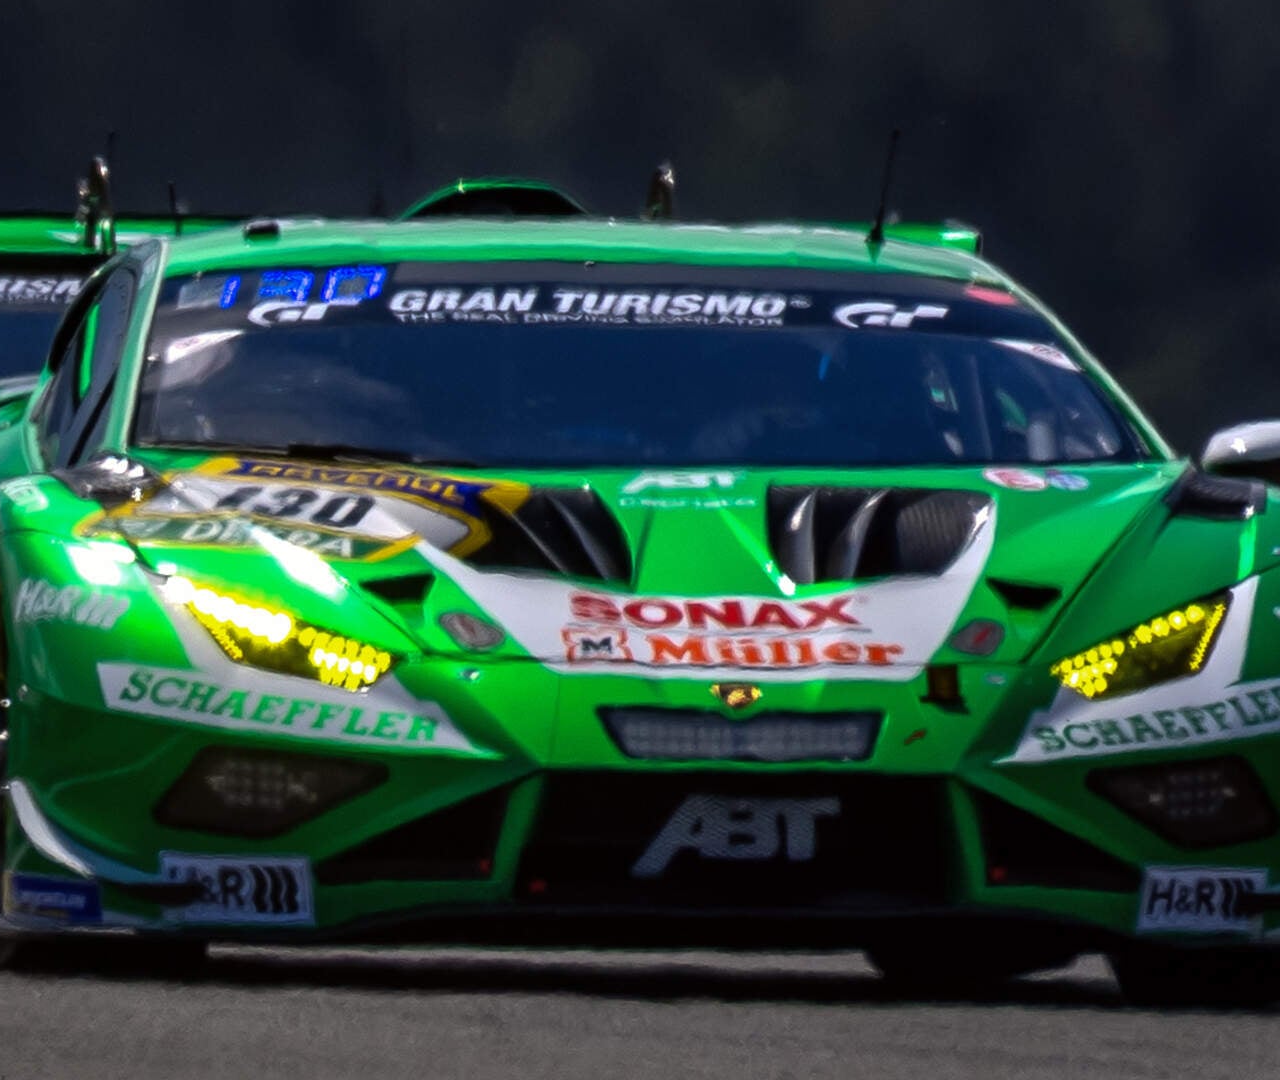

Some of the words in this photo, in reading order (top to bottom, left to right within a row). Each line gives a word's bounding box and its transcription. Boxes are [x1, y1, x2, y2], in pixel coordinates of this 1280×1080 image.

[389, 287, 537, 312] GRAN
[552, 288, 787, 317] TURISMO
[247, 463, 467, 507] RAVENOL
[215, 484, 377, 529] 130
[567, 590, 860, 630] SONAX
[648, 633, 904, 667] Müller
[120, 669, 439, 743] SCHAEFFLER
[630, 793, 841, 879] ABT
[1145, 877, 1220, 918] H&R
